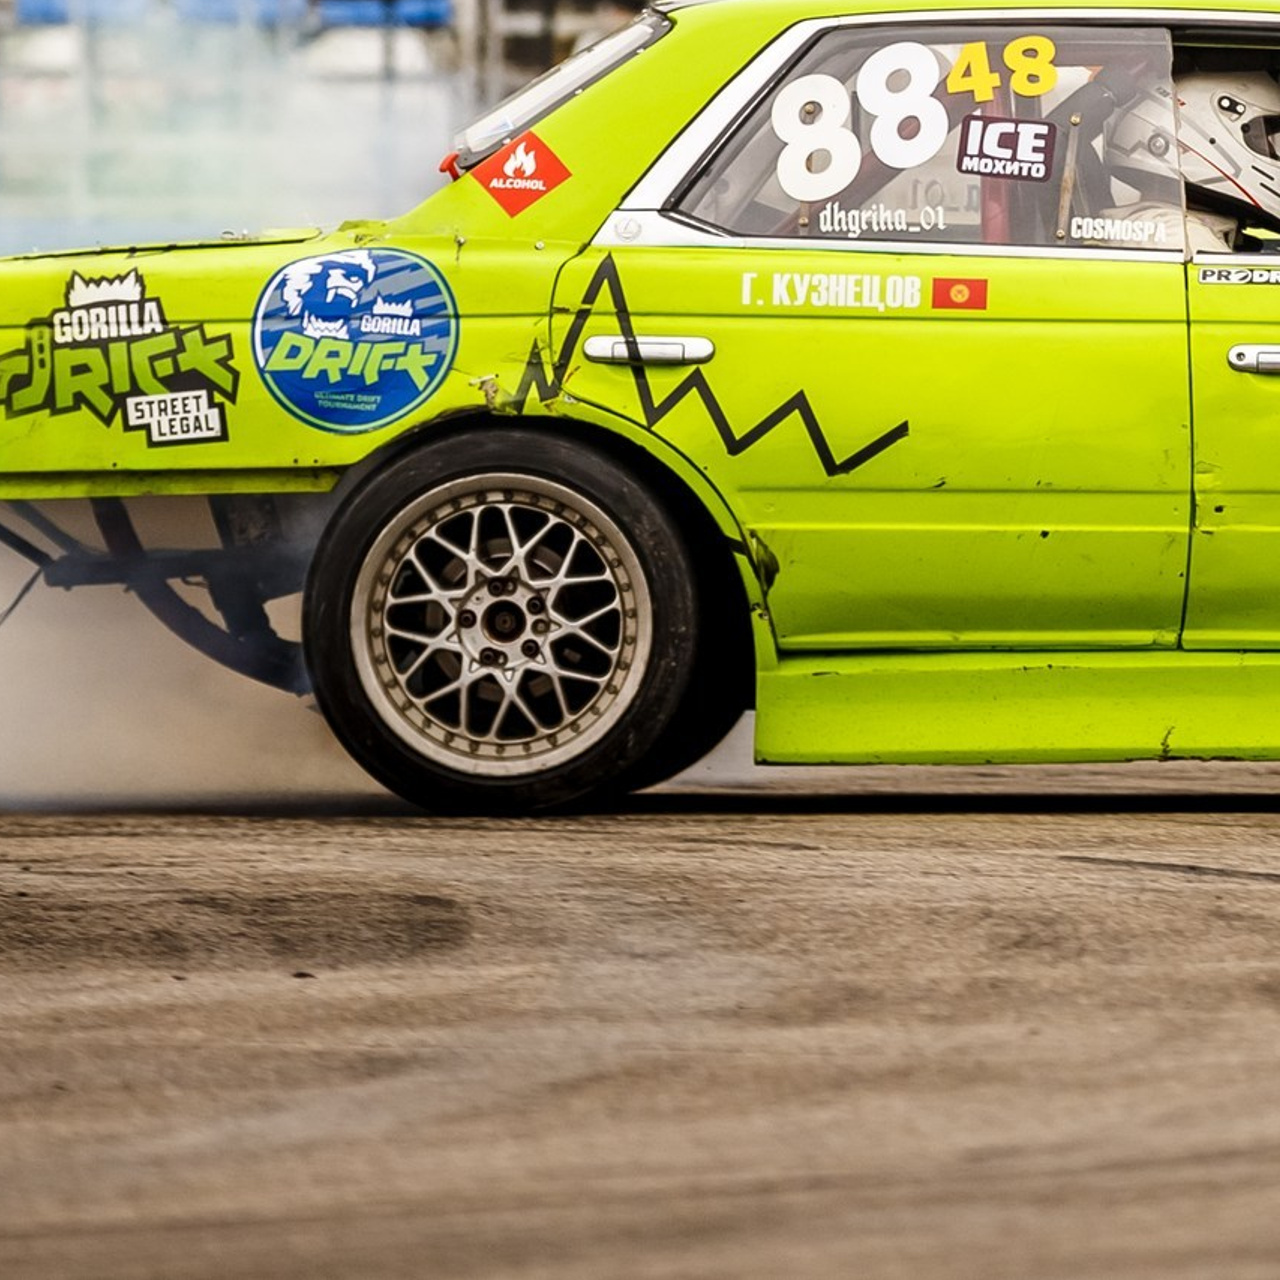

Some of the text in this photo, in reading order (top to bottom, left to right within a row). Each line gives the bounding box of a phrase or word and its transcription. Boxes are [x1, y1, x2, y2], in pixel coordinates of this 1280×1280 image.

[947, 36, 1057, 102] 48
[771, 42, 949, 201] 88
[967, 120, 1049, 162] ICE
[962, 157, 1046, 178] МОХИТО
[489, 178, 547, 191] ALCOHOL
[1071, 217, 1167, 242] COSMOSPA
[741, 272, 922, 312] Г. КУЗНЕЦОВ
[53, 301, 164, 344] GORILLA
[360, 314, 422, 336] GORILLA
[265, 331, 438, 391] DRIFT
[134, 395, 203, 419] STREET
[157, 414, 215, 437] LEGAL
